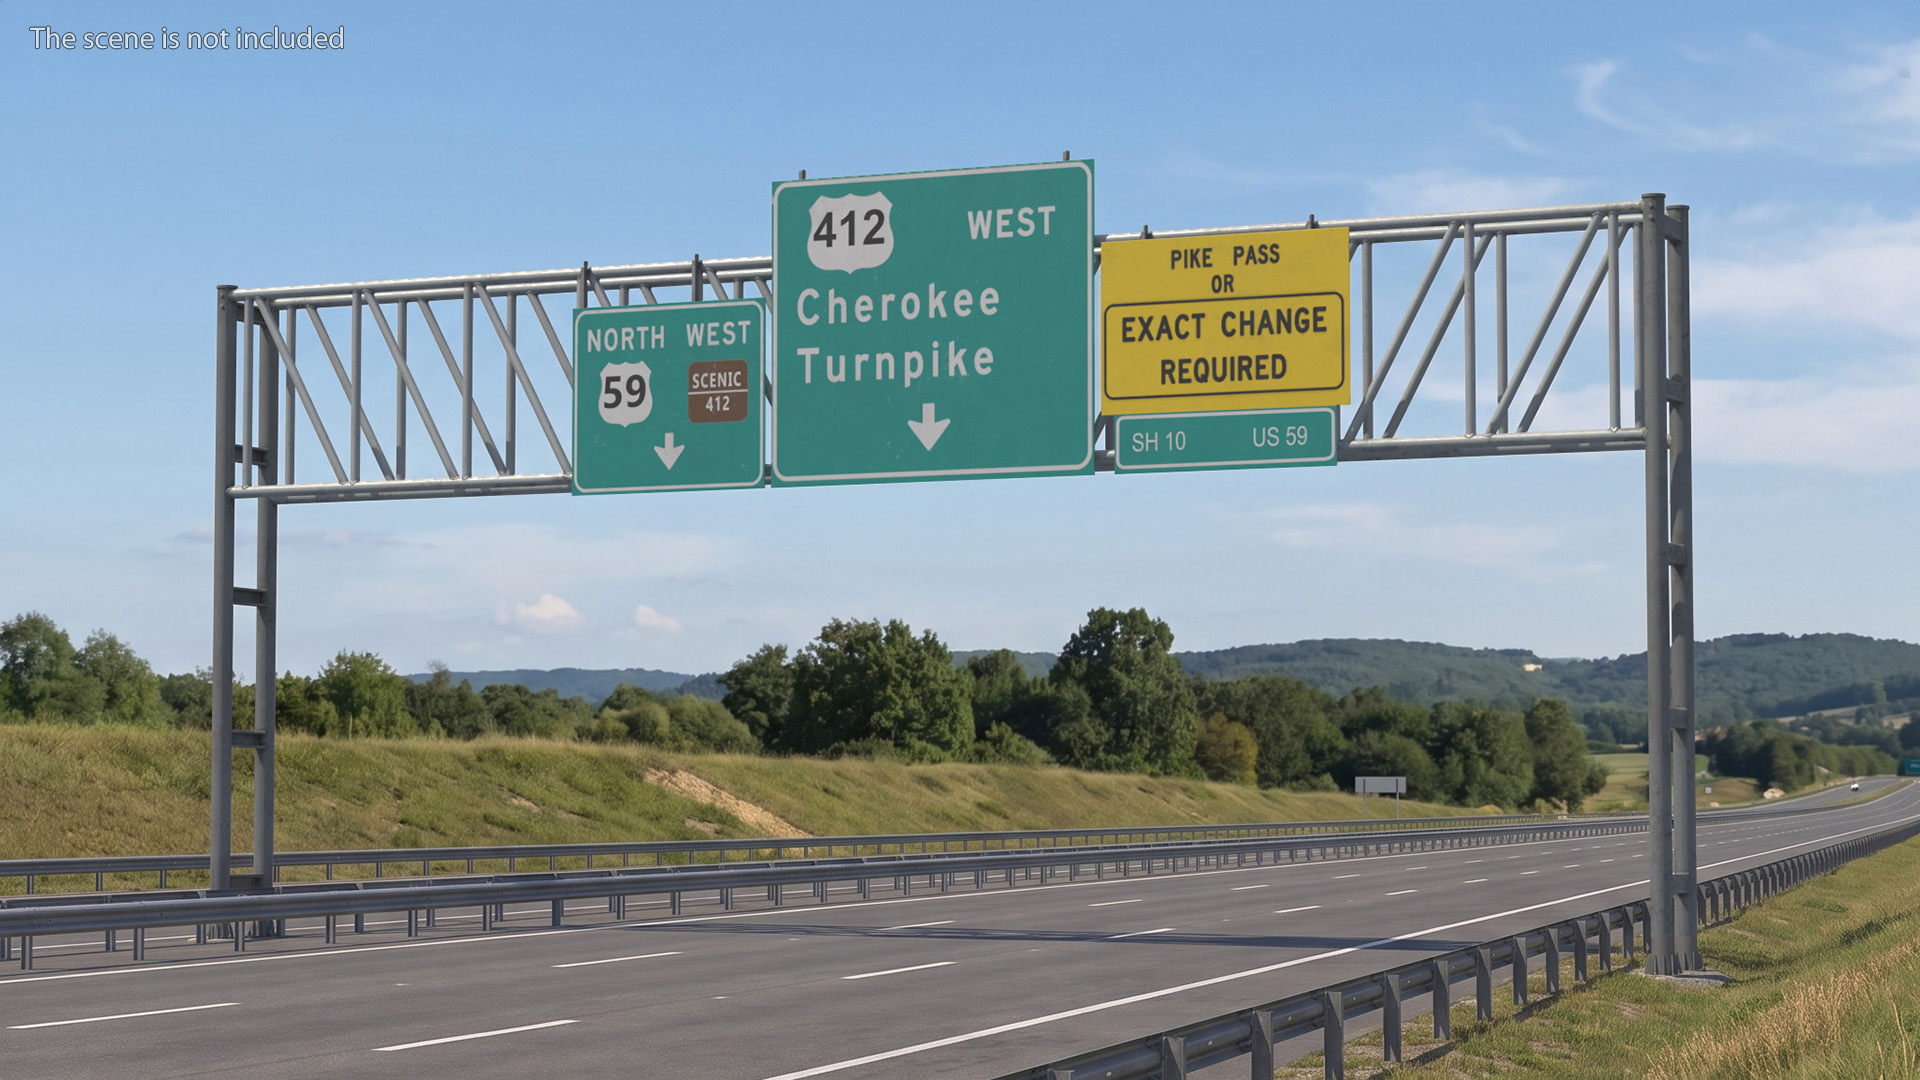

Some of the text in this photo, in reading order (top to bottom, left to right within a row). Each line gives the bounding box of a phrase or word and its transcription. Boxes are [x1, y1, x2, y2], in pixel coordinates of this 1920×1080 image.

[813, 208, 886, 248] 412
[967, 205, 1056, 240] WEST
[1171, 243, 1281, 270] PIKE PASS
[1211, 274, 1234, 294] OR
[797, 282, 1000, 326] Cherokee
[587, 320, 751, 352] NORTH WEST
[1122, 306, 1327, 343] EXACT CHANGE
[692, 371, 742, 389] SCENIC
[797, 340, 994, 388] Turnpike
[1161, 353, 1287, 385] REQUIRED
[603, 374, 646, 409] 59
[705, 395, 730, 412] 412
[1132, 430, 1186, 452] SH 10
[1253, 425, 1308, 447] US 59
